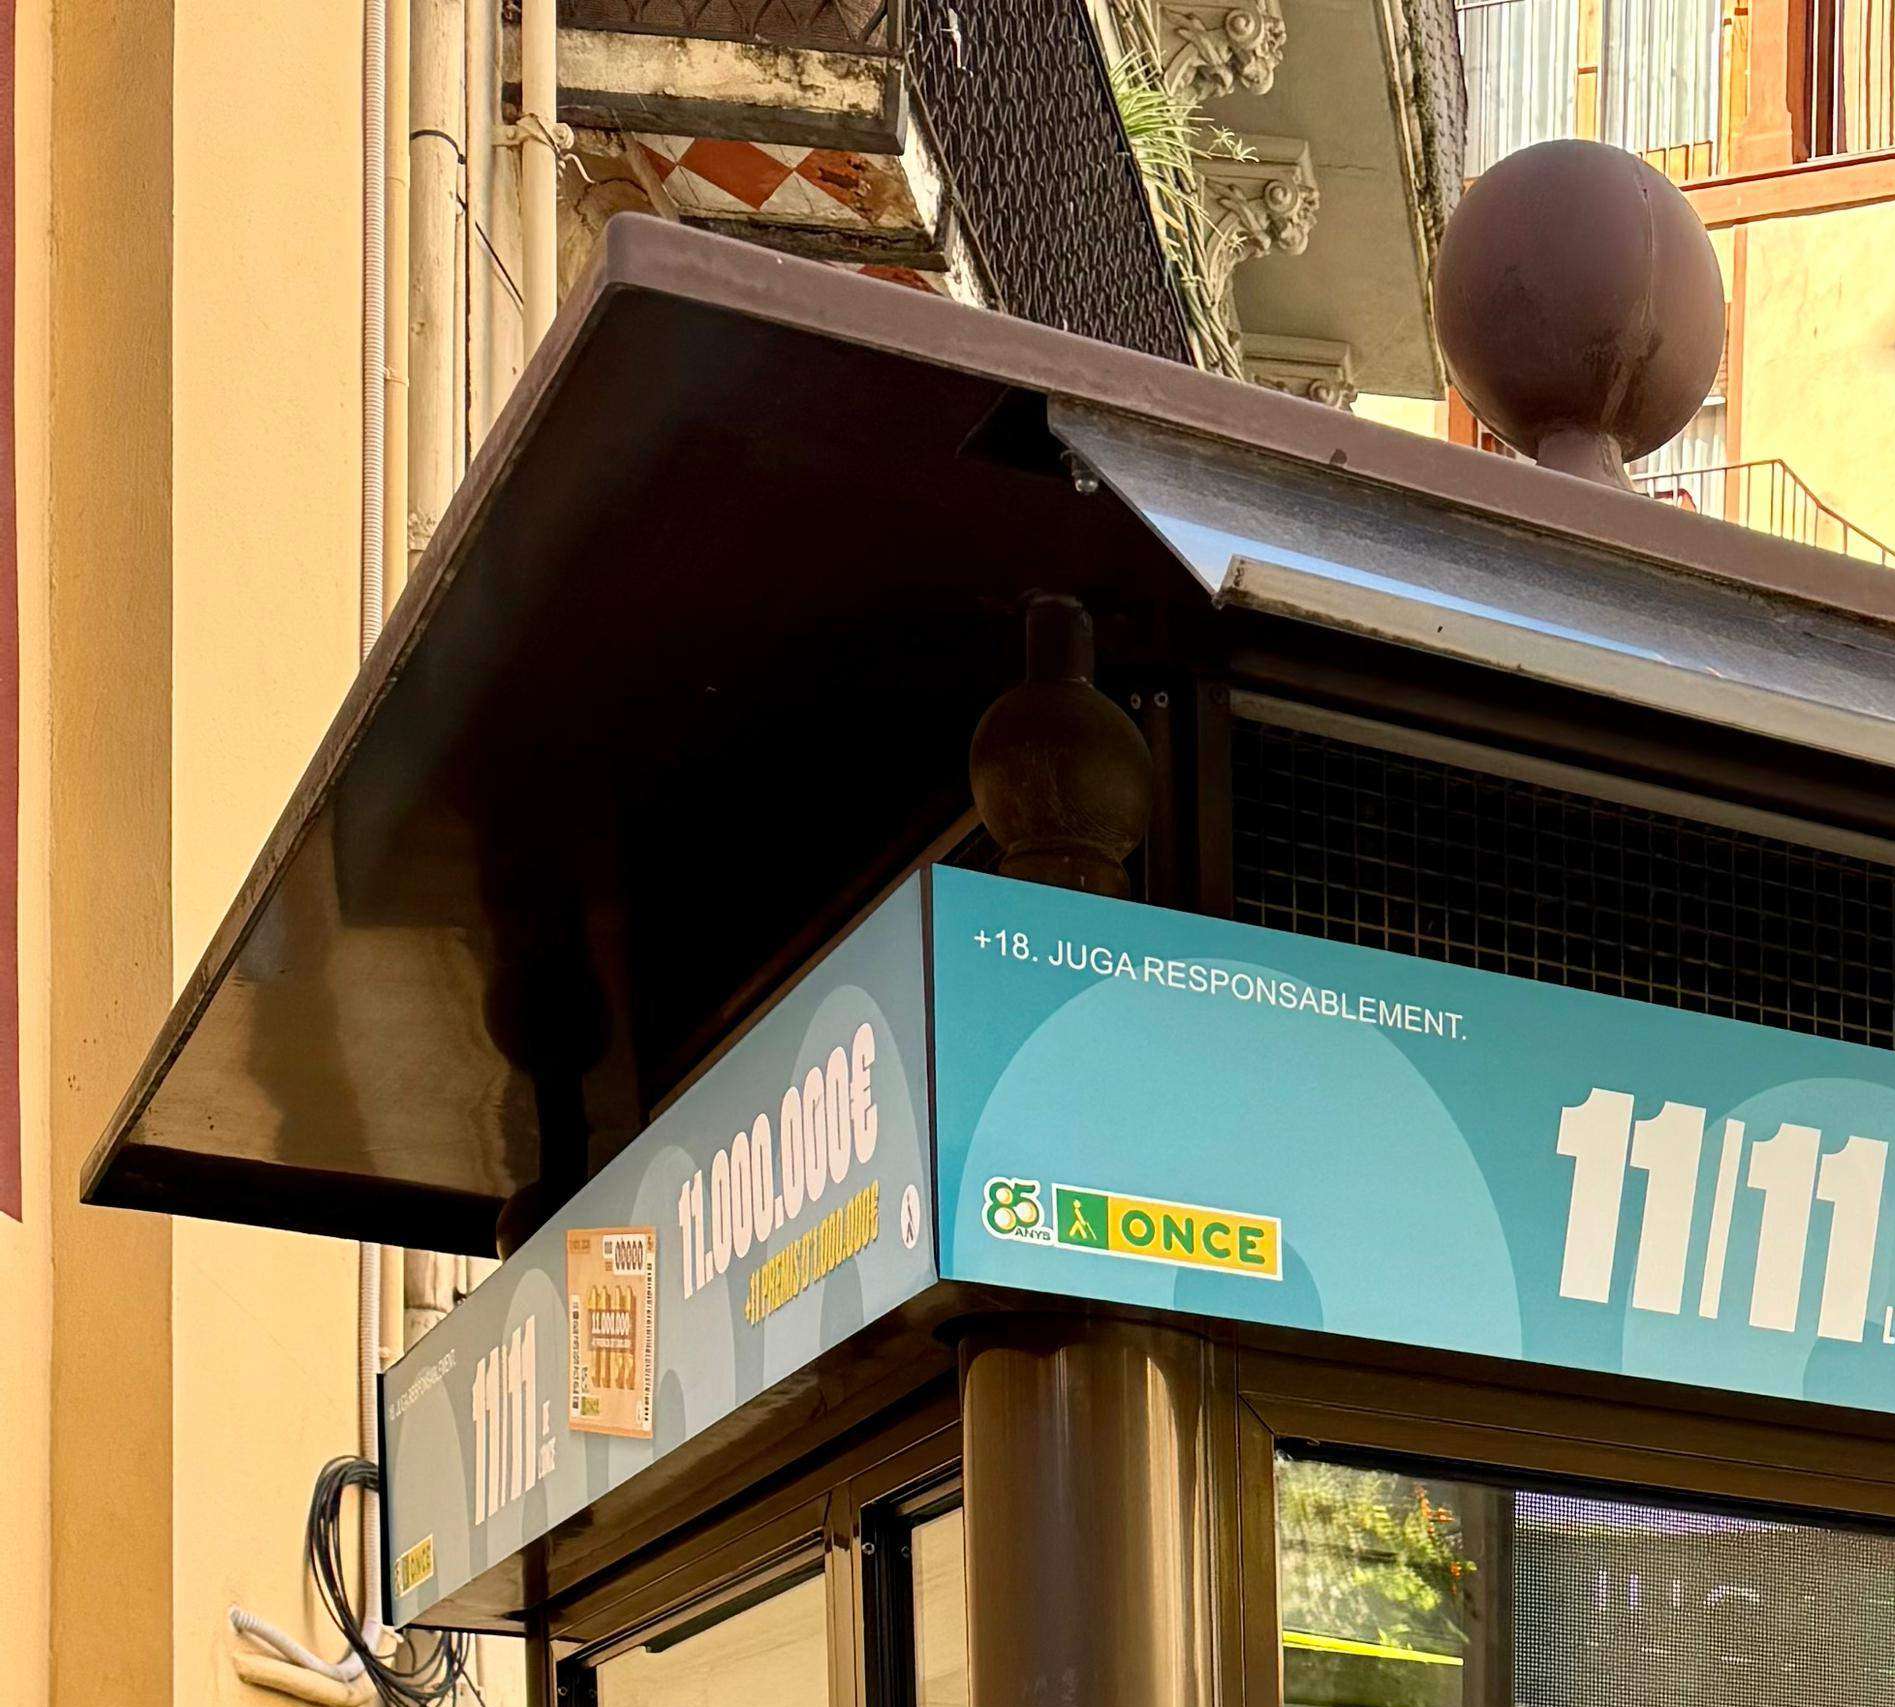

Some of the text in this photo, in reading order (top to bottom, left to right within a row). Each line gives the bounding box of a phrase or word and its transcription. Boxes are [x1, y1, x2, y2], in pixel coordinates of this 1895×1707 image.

[974, 930, 1467, 1041] +18. JUGA RESPONSABLEMENT.
[679, 1023, 878, 1300] 11.000.000€
[988, 1181, 1040, 1234] 85
[1556, 1088, 1888, 1343] 11/11
[1121, 1209, 1266, 1264] ONCE
